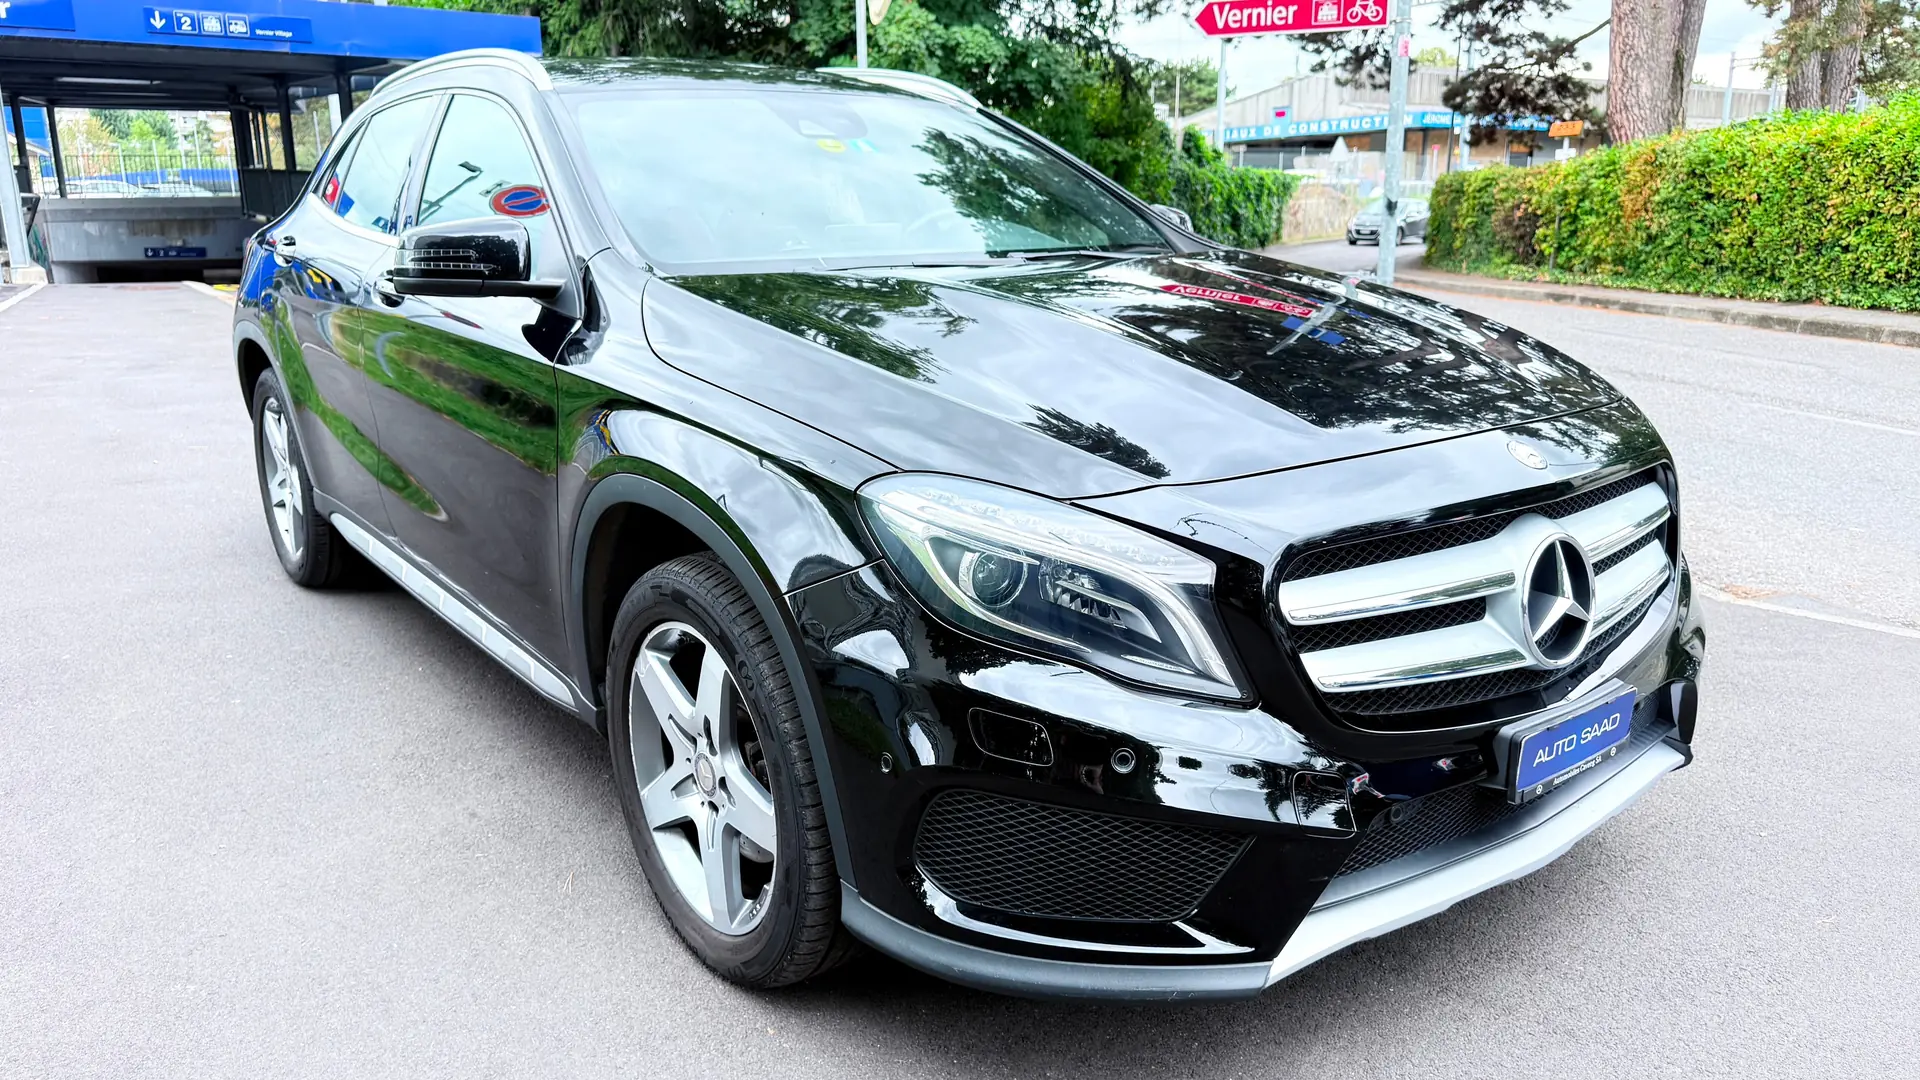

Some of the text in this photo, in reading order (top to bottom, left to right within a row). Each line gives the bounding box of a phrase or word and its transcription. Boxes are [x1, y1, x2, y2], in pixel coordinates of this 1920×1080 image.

[181, 16, 192, 30] 2
[1212, 1, 1298, 29] Vernier
[275, 30, 292, 38] Village
[1263, 126, 1281, 136] DE
[1288, 115, 1414, 134] CONSTRUCTIN
[1533, 713, 1620, 767] AUTO SAAD
